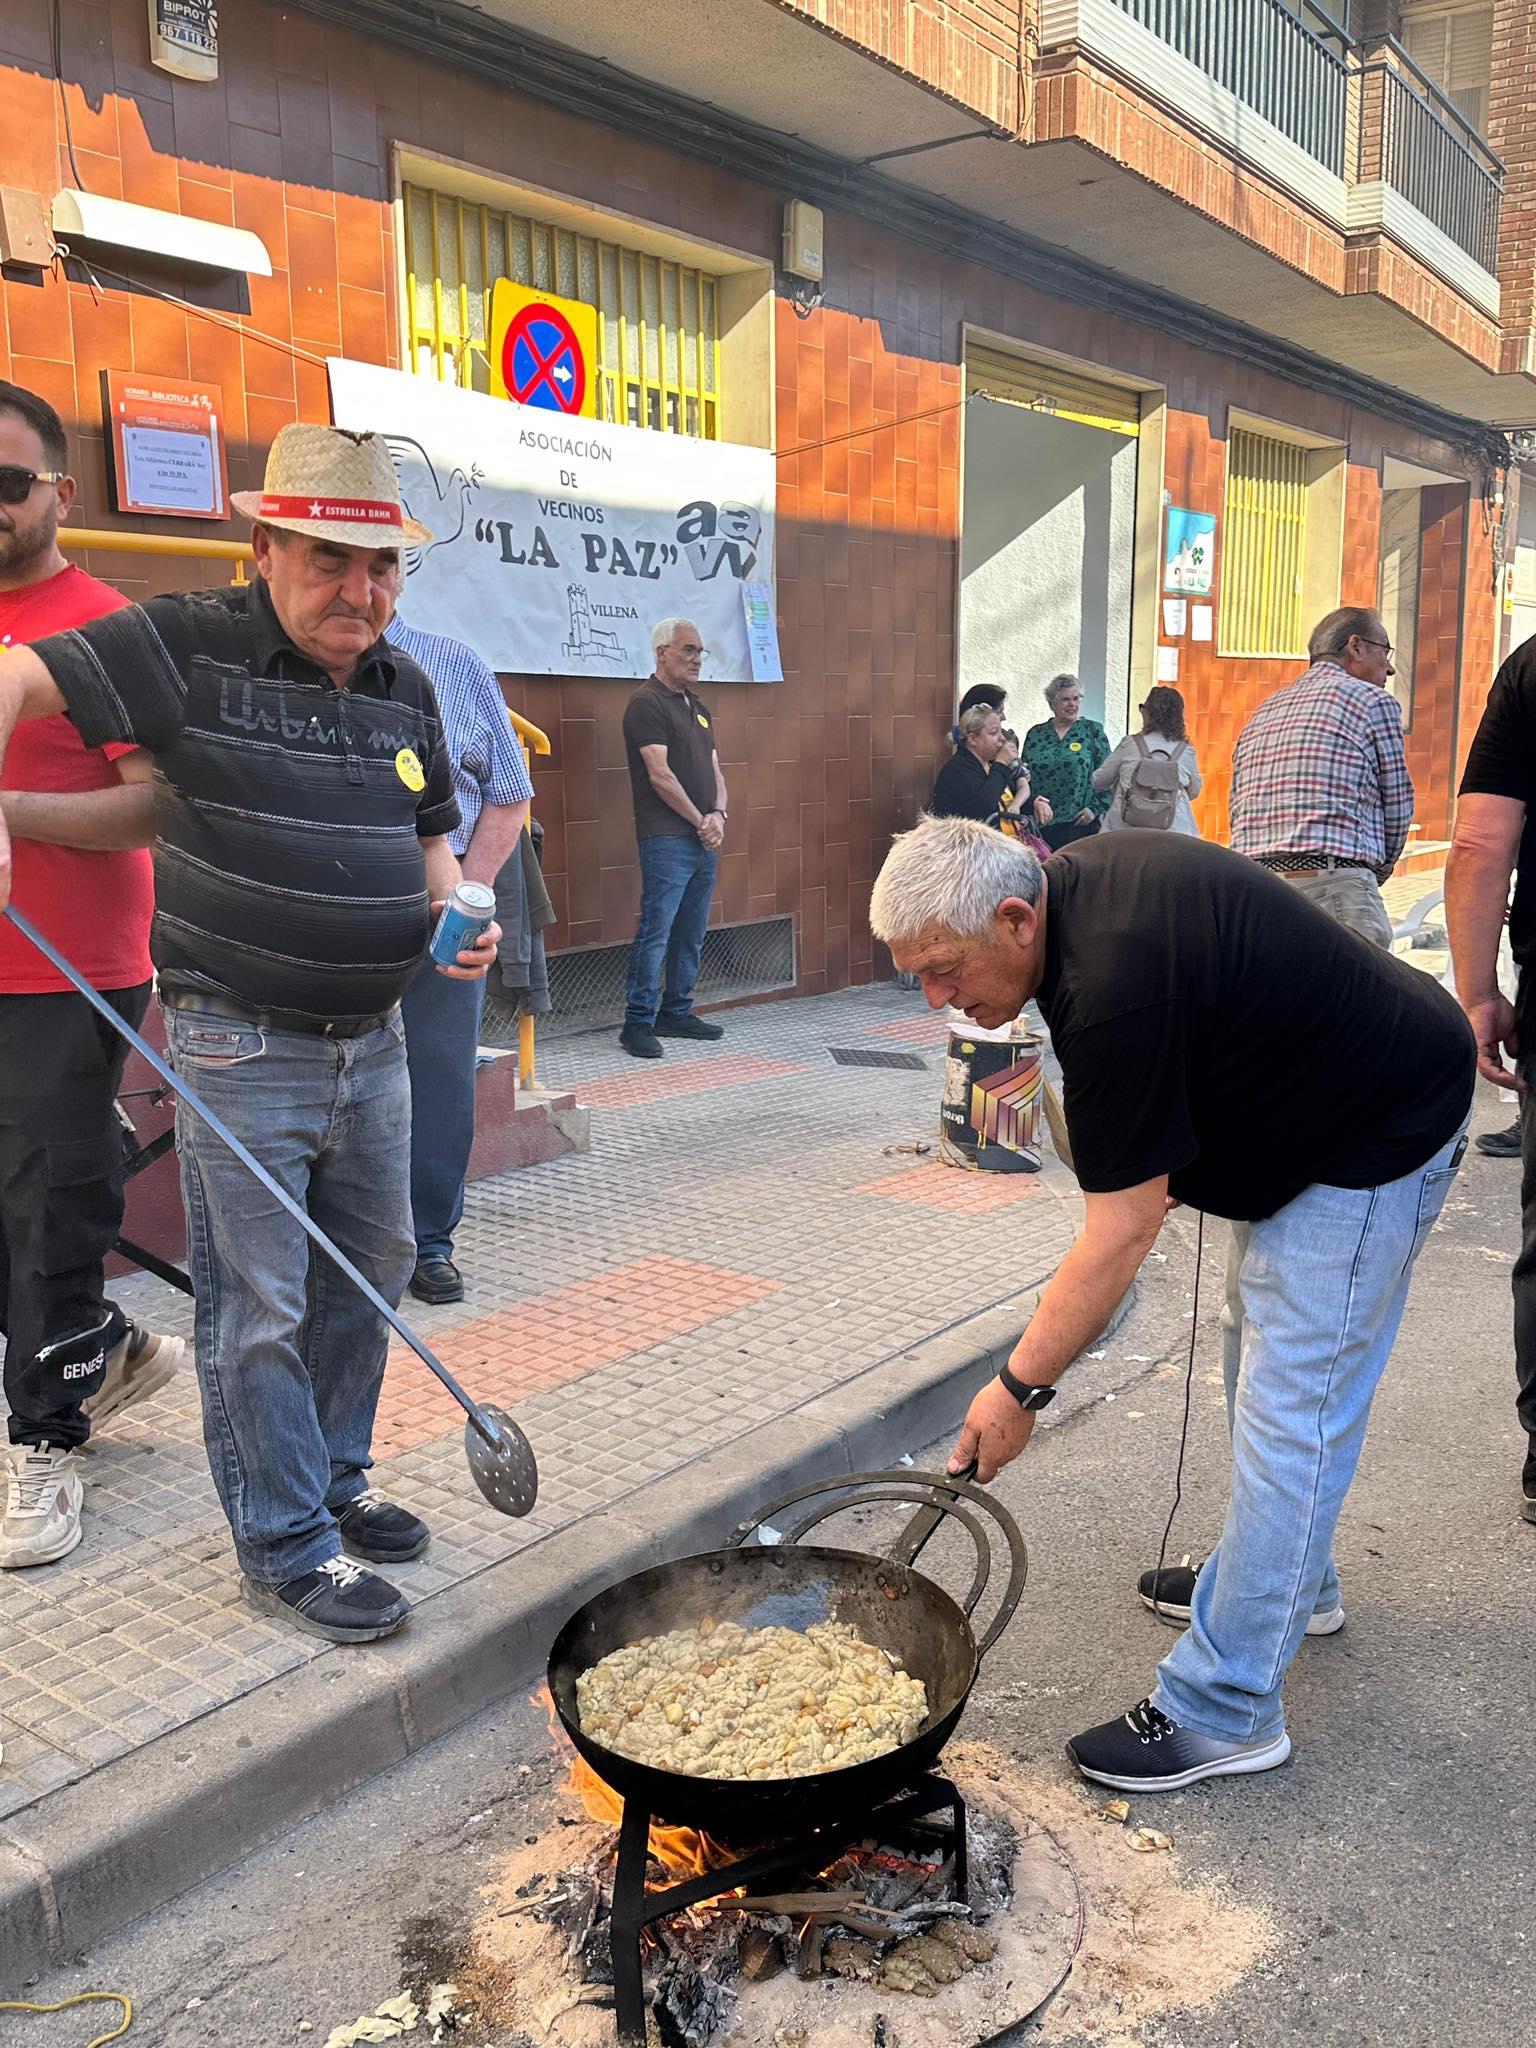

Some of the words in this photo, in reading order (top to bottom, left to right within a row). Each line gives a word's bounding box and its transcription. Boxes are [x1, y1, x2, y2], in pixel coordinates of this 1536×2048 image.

[164, 0, 206, 22] BIPROT
[160, 24, 180, 38] 967
[184, 31, 202, 46] 118
[152, 391, 190, 404] BIBLIOTECA
[519, 429, 612, 461] ASOCIACIÓN
[560, 470, 578, 488] DE
[325, 506, 366, 517] ESTRELLA
[368, 508, 391, 519] DAMM
[538, 499, 604, 523] VECINOS
[590, 604, 638, 619] VILLENA
